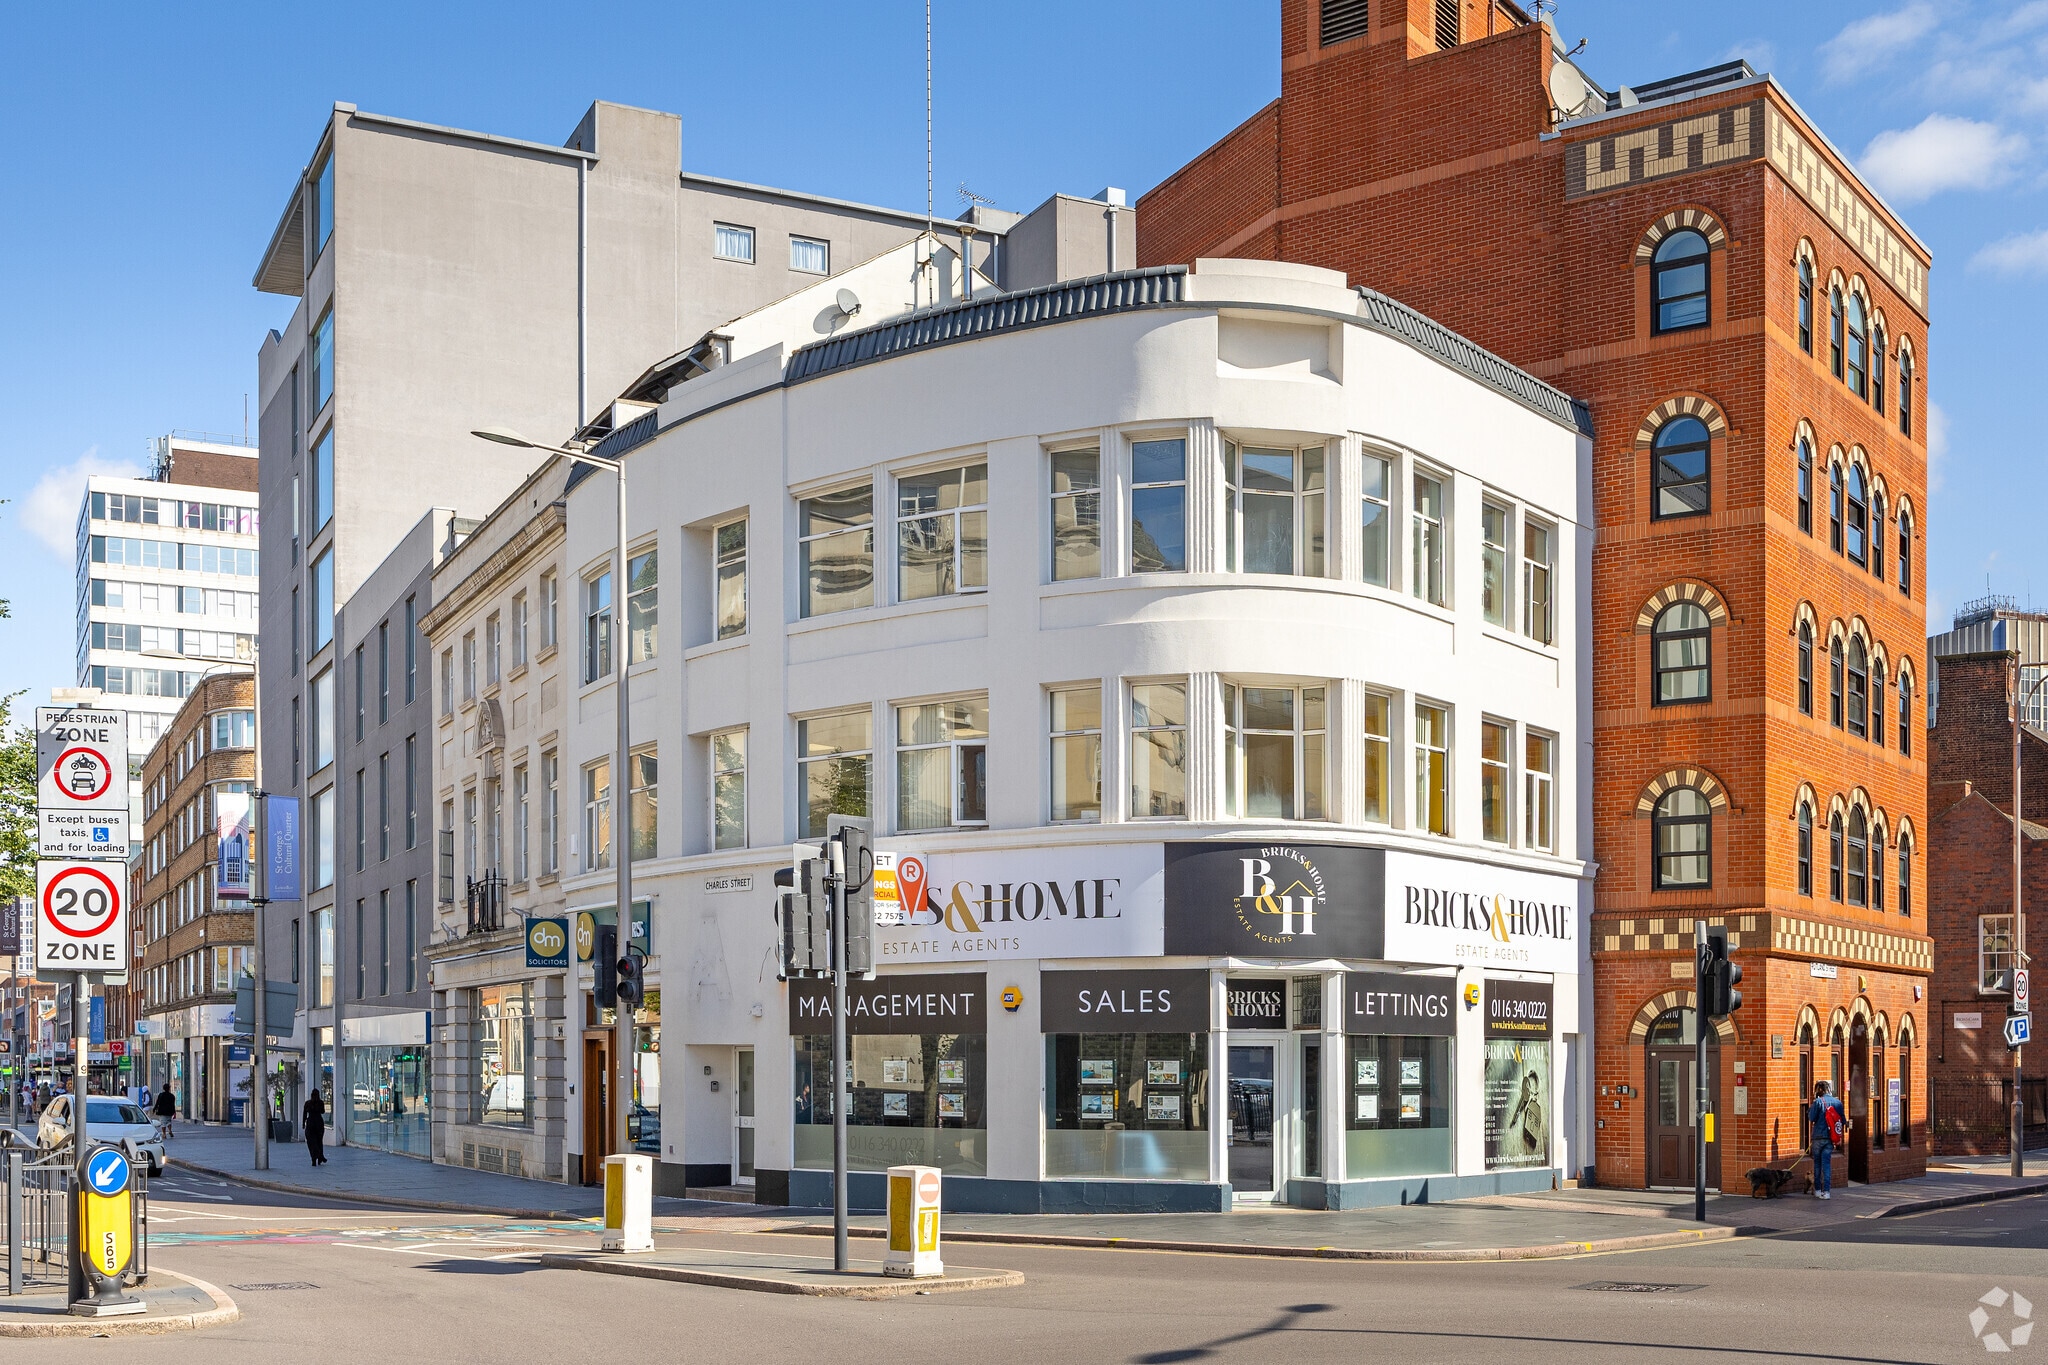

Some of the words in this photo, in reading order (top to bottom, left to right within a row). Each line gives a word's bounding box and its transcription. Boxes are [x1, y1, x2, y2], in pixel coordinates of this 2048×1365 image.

[46, 713, 118, 724] PEDESTRIAN
[55, 727, 109, 743] ZONE
[47, 814, 84, 825] Except
[88, 815, 120, 824] buses
[284, 812, 294, 841] Quarter
[44, 843, 64, 851] and
[68, 843, 82, 851] for
[87, 843, 125, 853] loading
[284, 842, 293, 874] Cultural
[873, 856, 892, 867] ET
[274, 865, 283, 874] St
[705, 880, 728, 890] CHARLES
[731, 877, 751, 888] STREET
[55, 888, 108, 917] 20
[1233, 897, 1253, 932] ESTATE
[1254, 931, 1293, 944] AGENTS
[533, 927, 561, 948] dm
[577, 921, 591, 947] dm
[46, 943, 116, 960] ZONE
[883, 940, 939, 955] ESTATE
[951, 936, 1021, 953] AGENTS
[1455, 944, 1489, 958] ESTATE
[1494, 948, 1529, 962] AGENTS
[528, 958, 568, 967] SOLICITORS
[2017, 980, 2025, 992] 20
[1078, 988, 1172, 1014] SALES
[1227, 990, 1281, 1004] BRICKS
[1355, 991, 1449, 1018] LETTINGS
[2015, 1001, 2027, 1010] ZONE
[1491, 999, 1512, 1018] 0116
[1512, 1000, 1527, 1018] 340
[1528, 1001, 1547, 1019] 0222
[2017, 1021, 2025, 1038] P
[849, 1135, 875, 1151] 0116
[877, 1136, 898, 1152] 340
